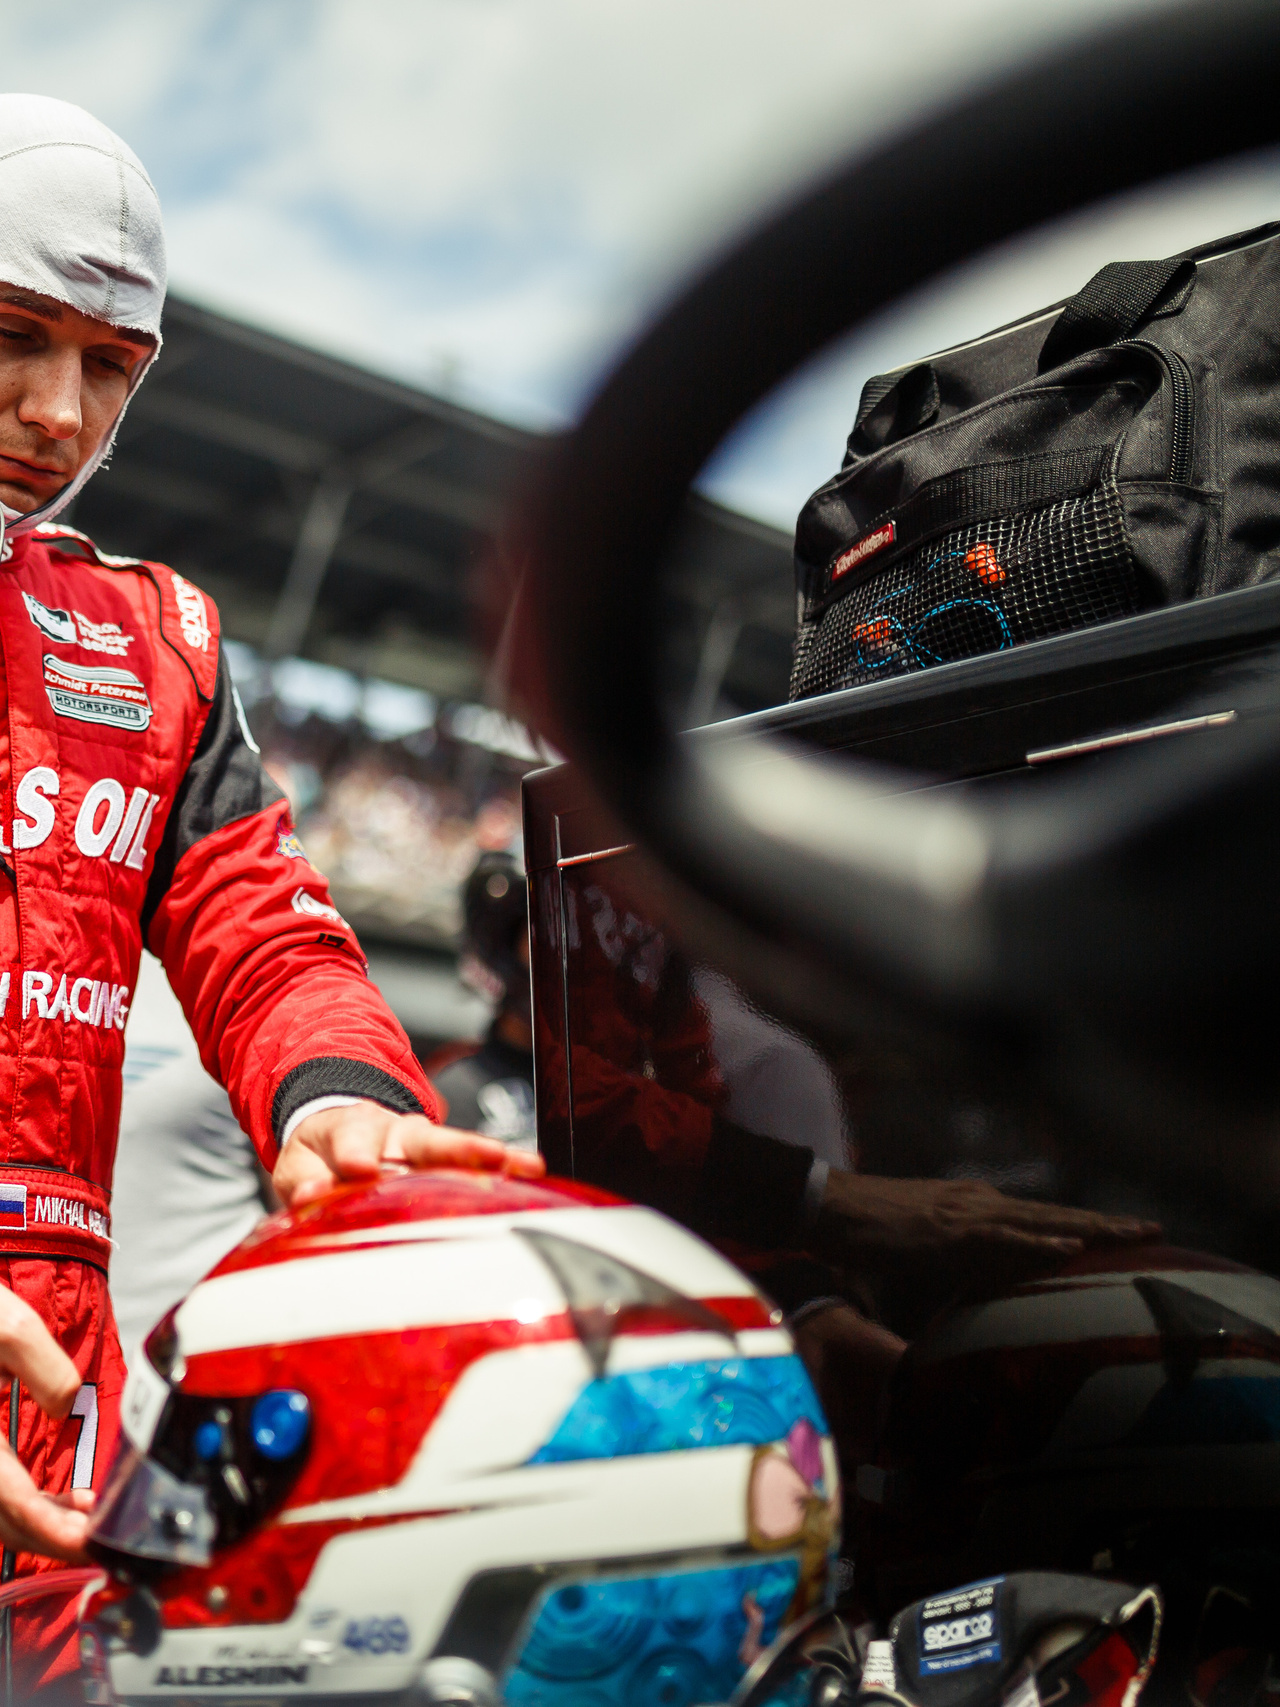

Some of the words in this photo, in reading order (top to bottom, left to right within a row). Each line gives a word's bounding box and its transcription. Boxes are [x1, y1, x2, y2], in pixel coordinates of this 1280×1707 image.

[55, 695, 140, 718] MOTORSPORTS
[74, 777, 160, 872] OIL
[22, 970, 130, 1031] RACING
[923, 1613, 993, 1651] sparco
